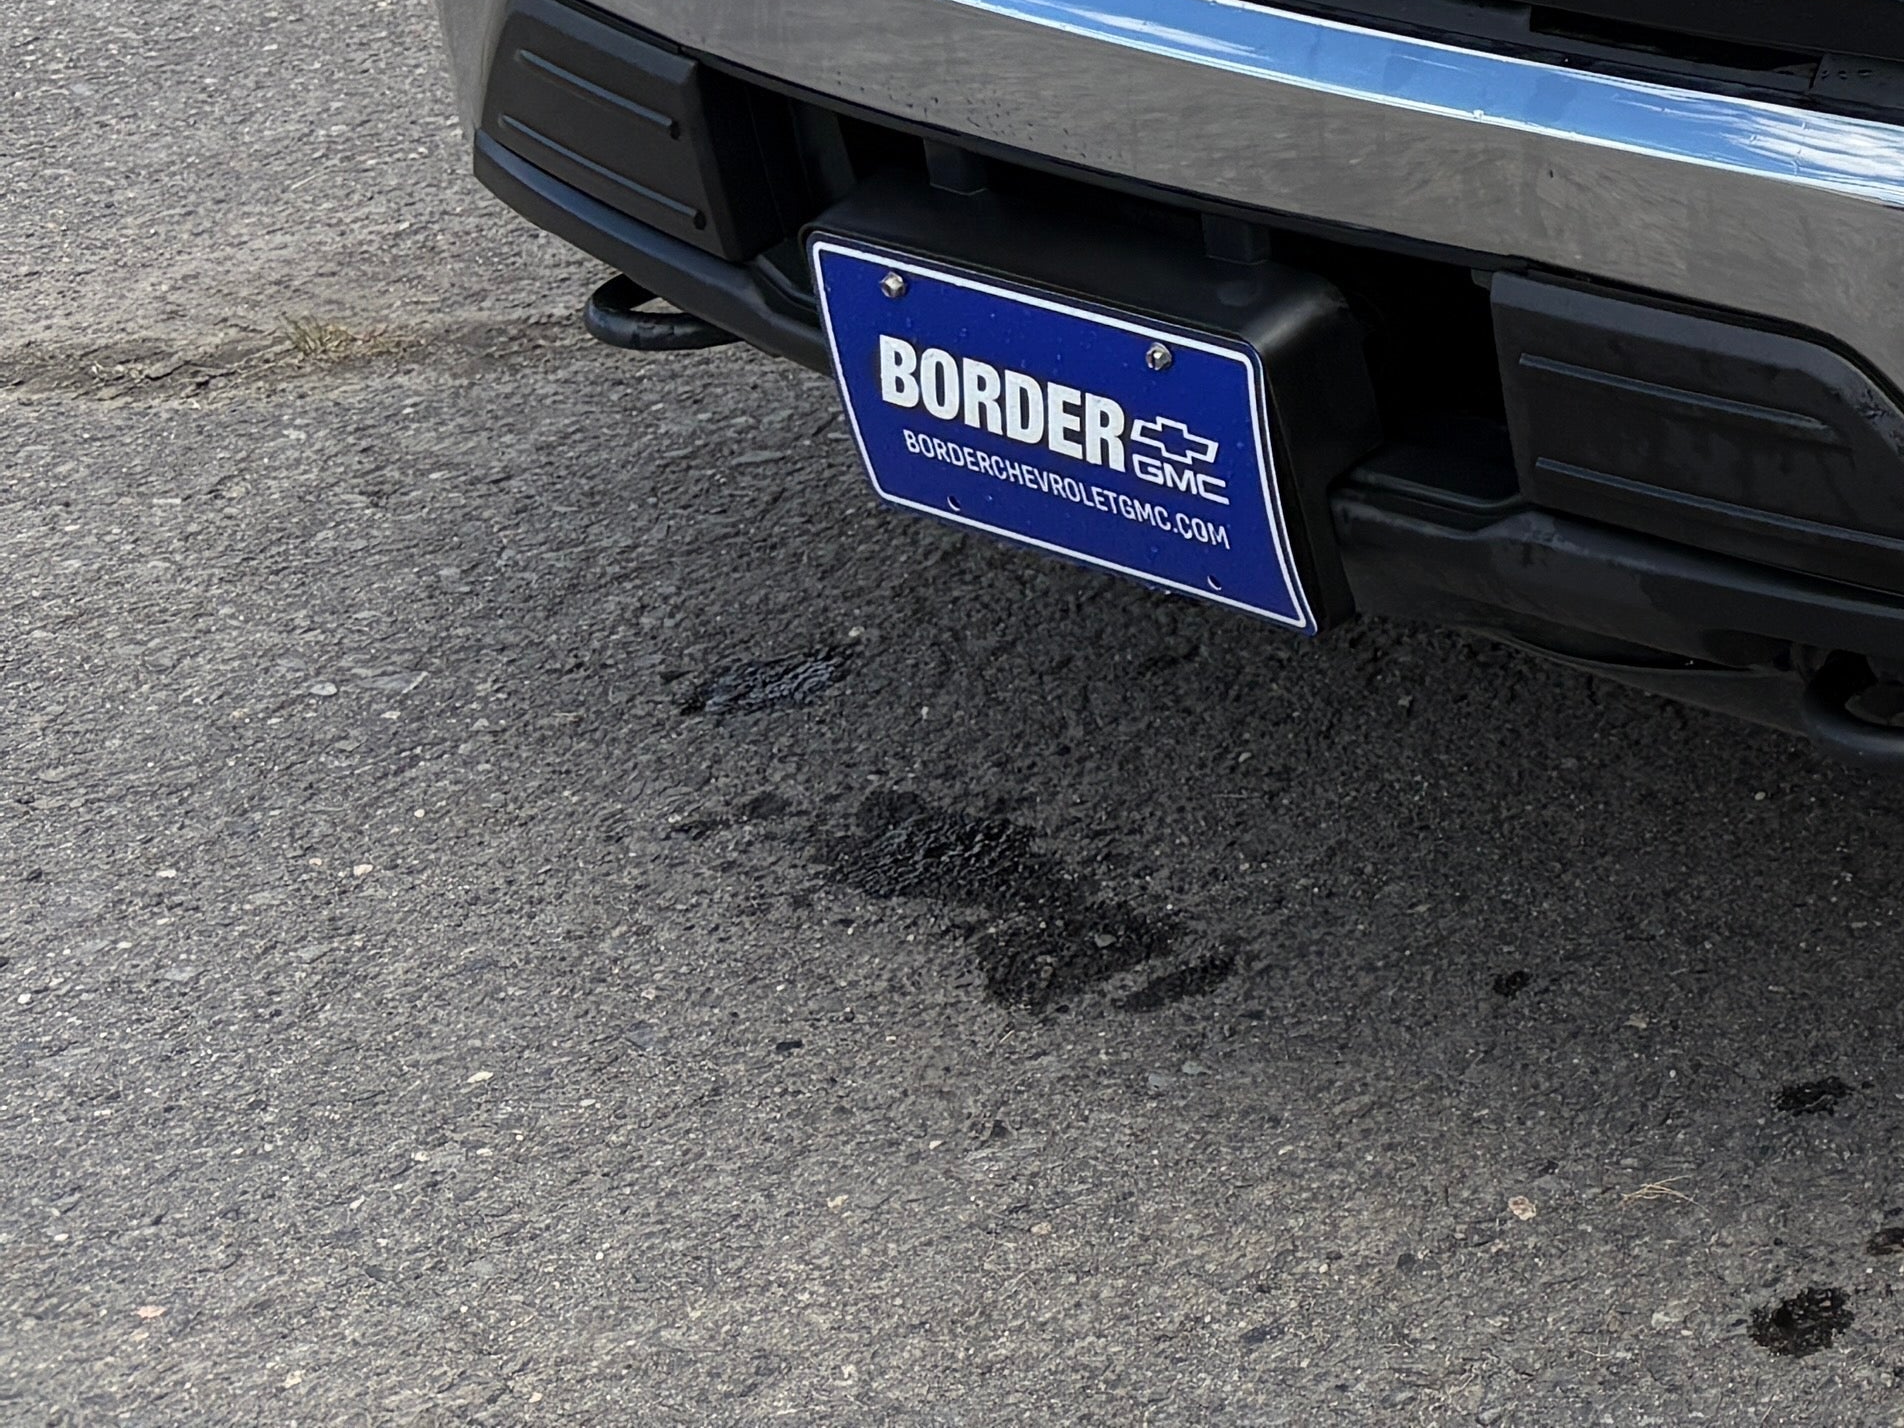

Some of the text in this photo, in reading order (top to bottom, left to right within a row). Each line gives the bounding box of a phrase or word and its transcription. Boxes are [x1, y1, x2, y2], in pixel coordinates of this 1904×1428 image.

[878, 334, 1126, 472] BORDER
[903, 429, 1231, 550] BORDERCHEVROLETGMC.COM
[1131, 455, 1230, 505] GMC
